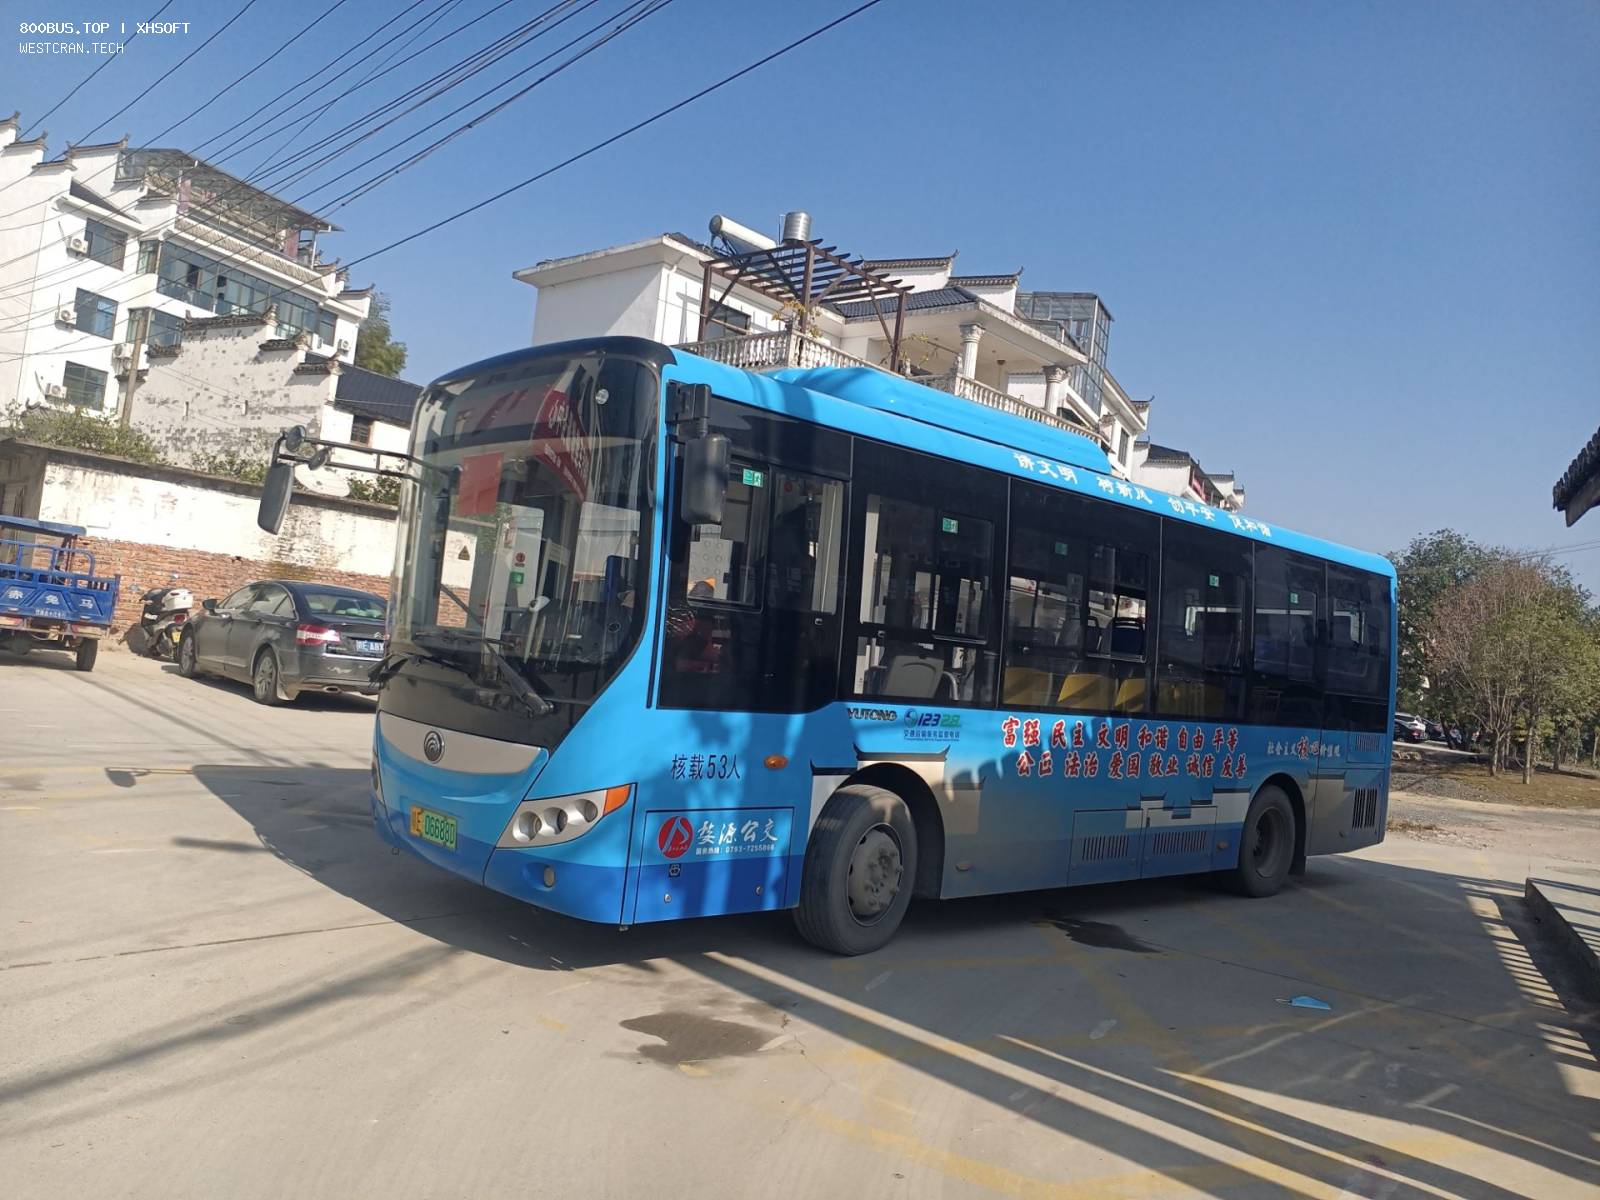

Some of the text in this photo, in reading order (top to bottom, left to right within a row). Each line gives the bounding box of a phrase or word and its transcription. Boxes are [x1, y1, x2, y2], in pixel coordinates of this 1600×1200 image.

[847, 708, 898, 721] YUTONG
[918, 712, 961, 728] 12328
[1002, 716, 1238, 753] 富强 民主 文明 和谐 自由 平等
[1016, 750, 1247, 779] 公正 法治 爱国 敬业 诚信 友善
[697, 818, 778, 845] 婺源公交
